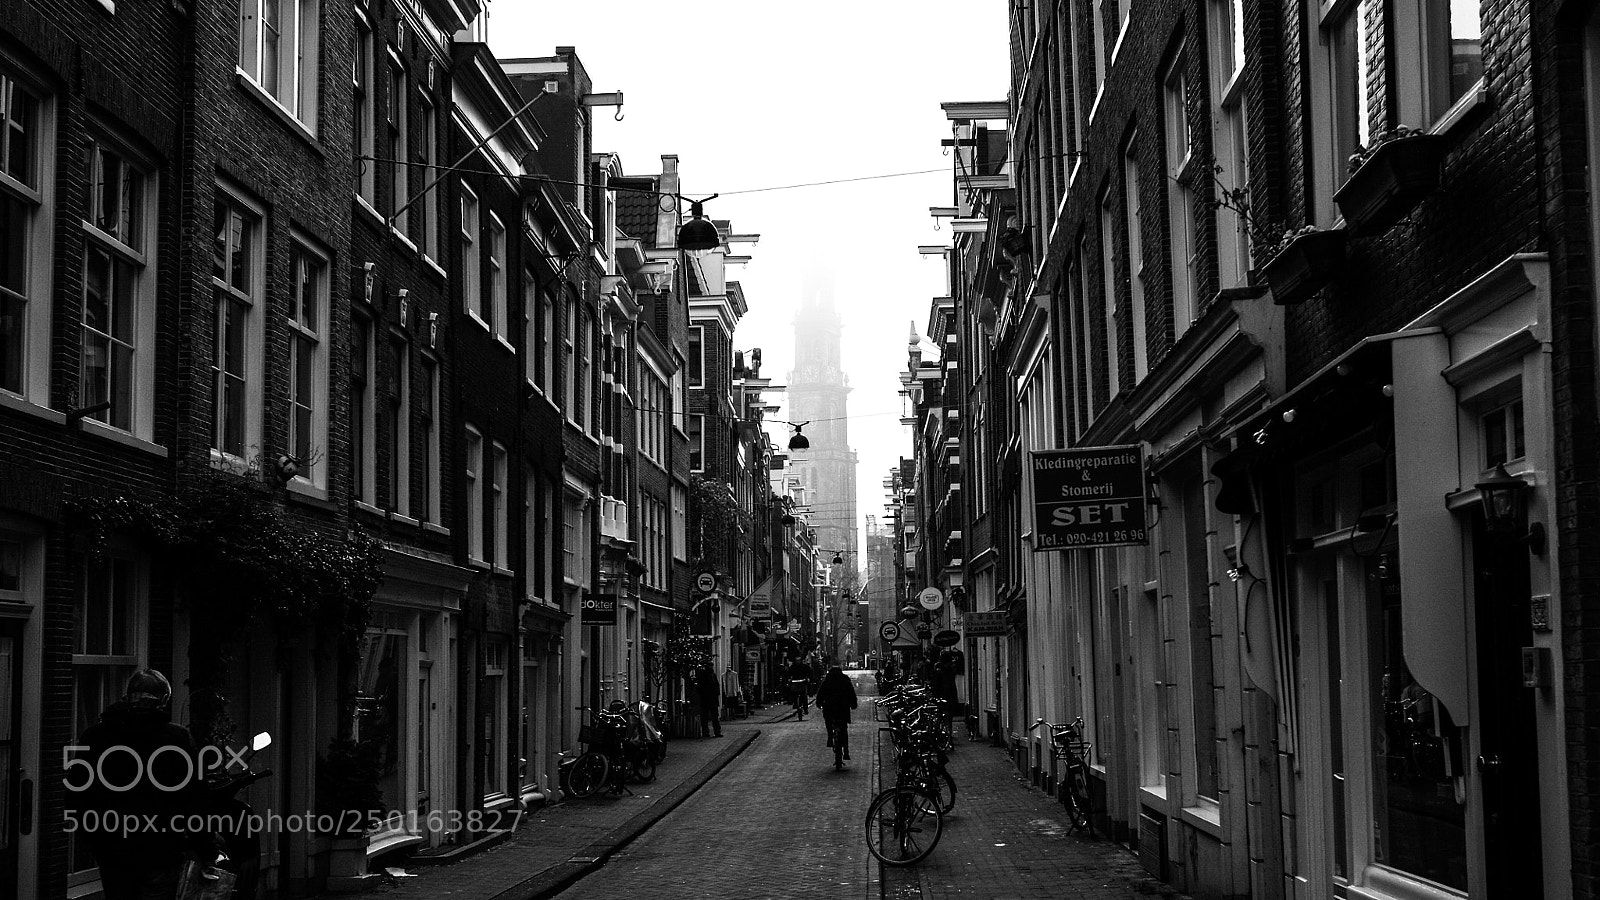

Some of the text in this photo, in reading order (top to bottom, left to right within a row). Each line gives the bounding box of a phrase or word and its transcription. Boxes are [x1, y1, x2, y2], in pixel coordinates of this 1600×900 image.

[1035, 453, 1136, 470] Kledingreparatie
[1081, 469, 1091, 481] &
[1061, 483, 1113, 497] Stomerij
[1051, 502, 1129, 526] SET
[1039, 529, 1144, 546] Tel.: 020-421 26 96
